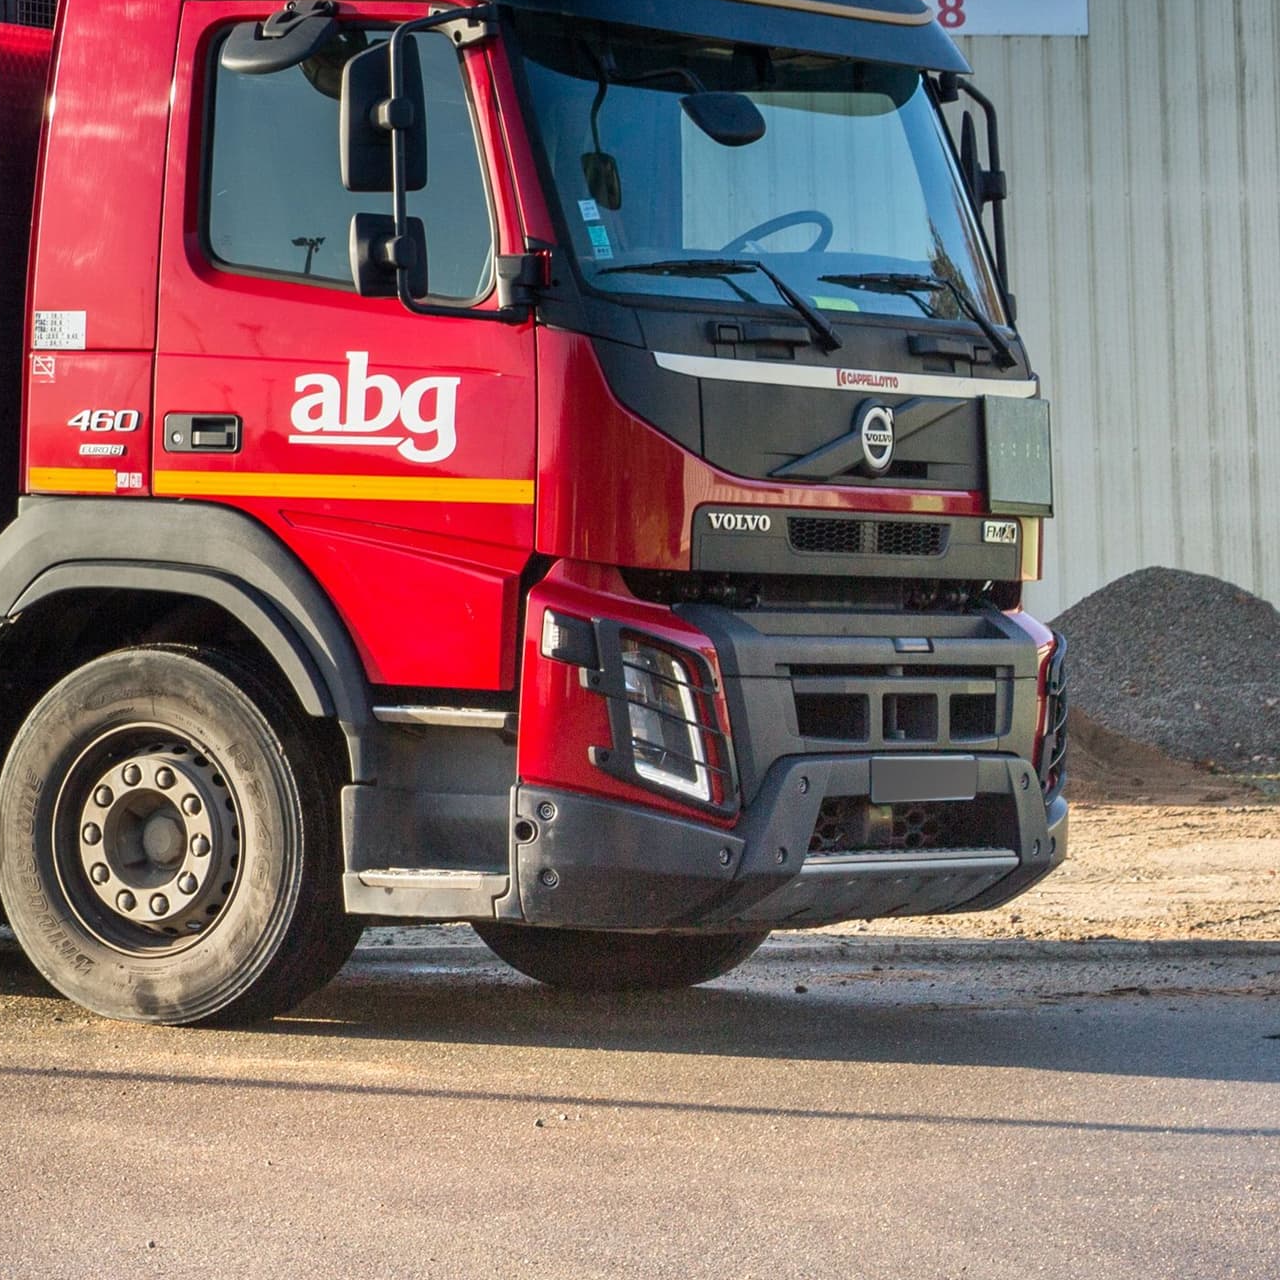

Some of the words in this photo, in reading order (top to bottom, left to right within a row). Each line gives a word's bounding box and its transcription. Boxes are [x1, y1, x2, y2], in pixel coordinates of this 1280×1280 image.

[847, 372, 899, 389] CAPPELLOTTO
[288, 350, 461, 464] abg
[66, 409, 140, 432] 460
[864, 432, 892, 442] VOLVO
[707, 511, 772, 532] VOLVO
